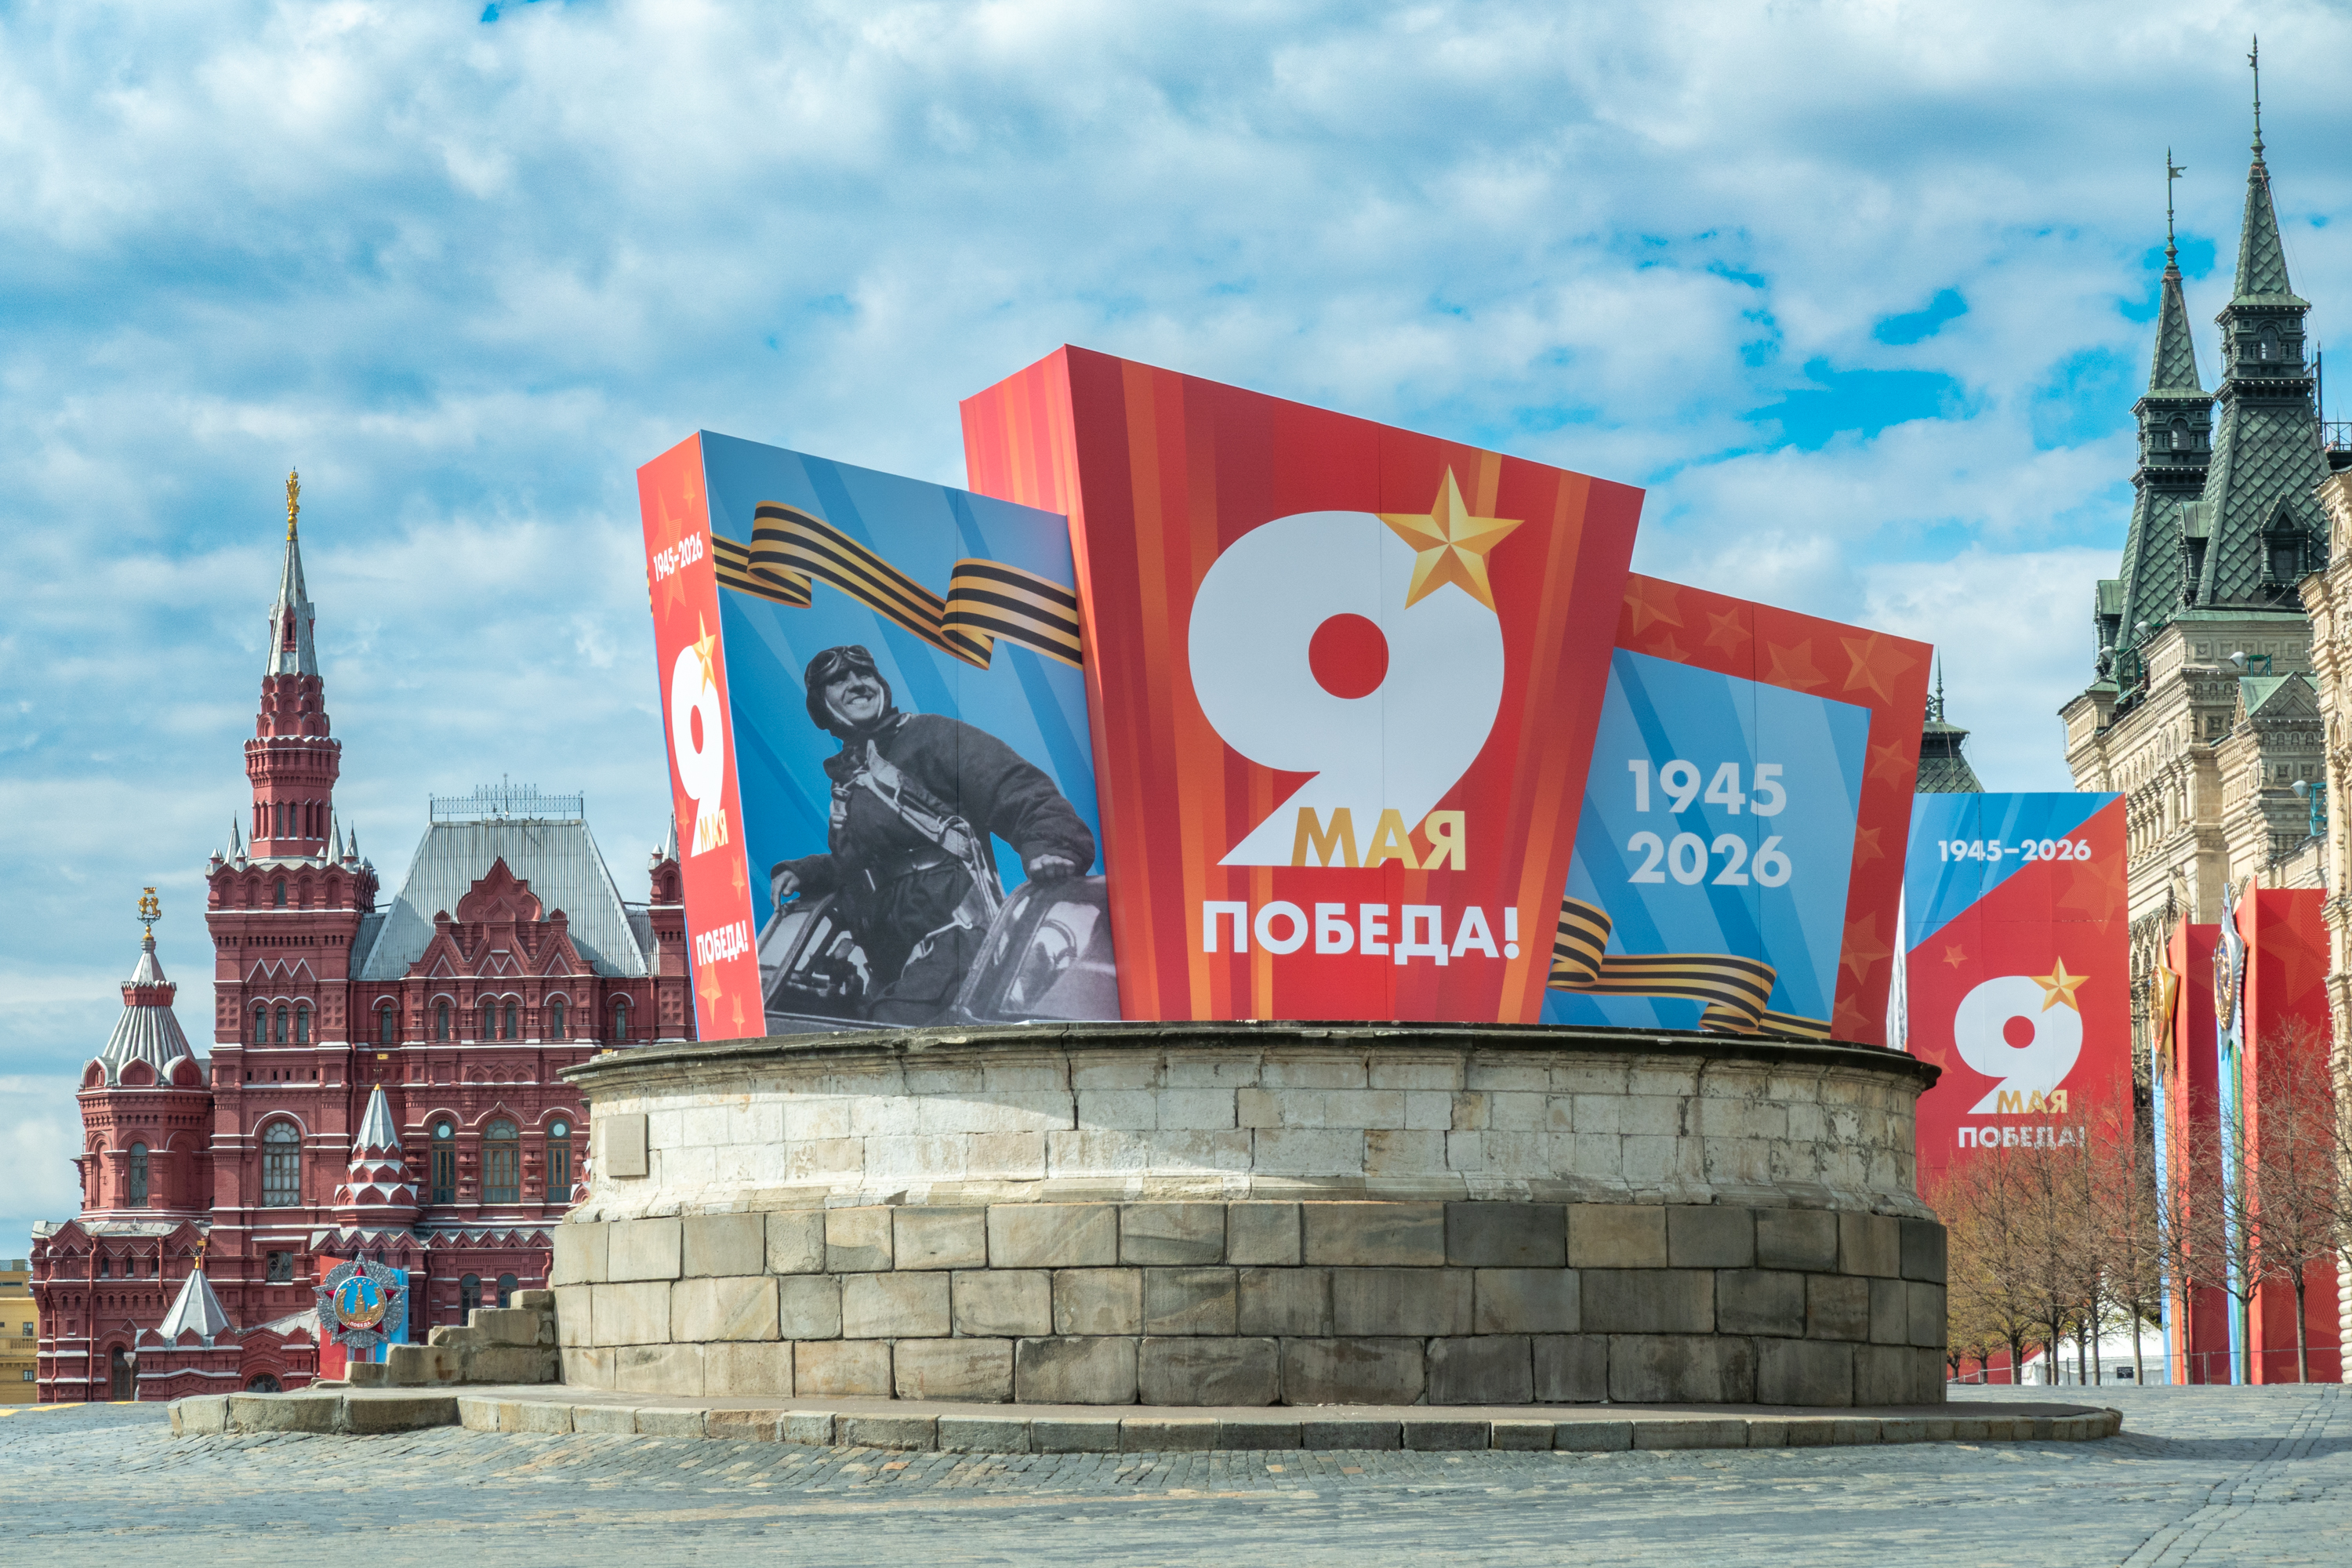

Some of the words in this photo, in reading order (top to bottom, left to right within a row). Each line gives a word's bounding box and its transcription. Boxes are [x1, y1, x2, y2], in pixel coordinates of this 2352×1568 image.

[653, 531, 703, 582] 1945–2026
[1188, 510, 1504, 866] 9
[671, 645, 724, 858] 9
[1628, 759, 1788, 817] 1945
[699, 808, 728, 853] МАЯ
[1290, 806, 1466, 870] МАЯ
[1627, 830, 1792, 887] 2026
[1938, 839, 2092, 862] 1945–2026
[696, 920, 749, 966] ПОБЕДА!
[1203, 900, 1520, 967] ПОБЕДА!
[1954, 975, 2083, 1114] 9
[1997, 1090, 2067, 1113] МАЯ
[1958, 1126, 2085, 1150] ПОБЕДА!
